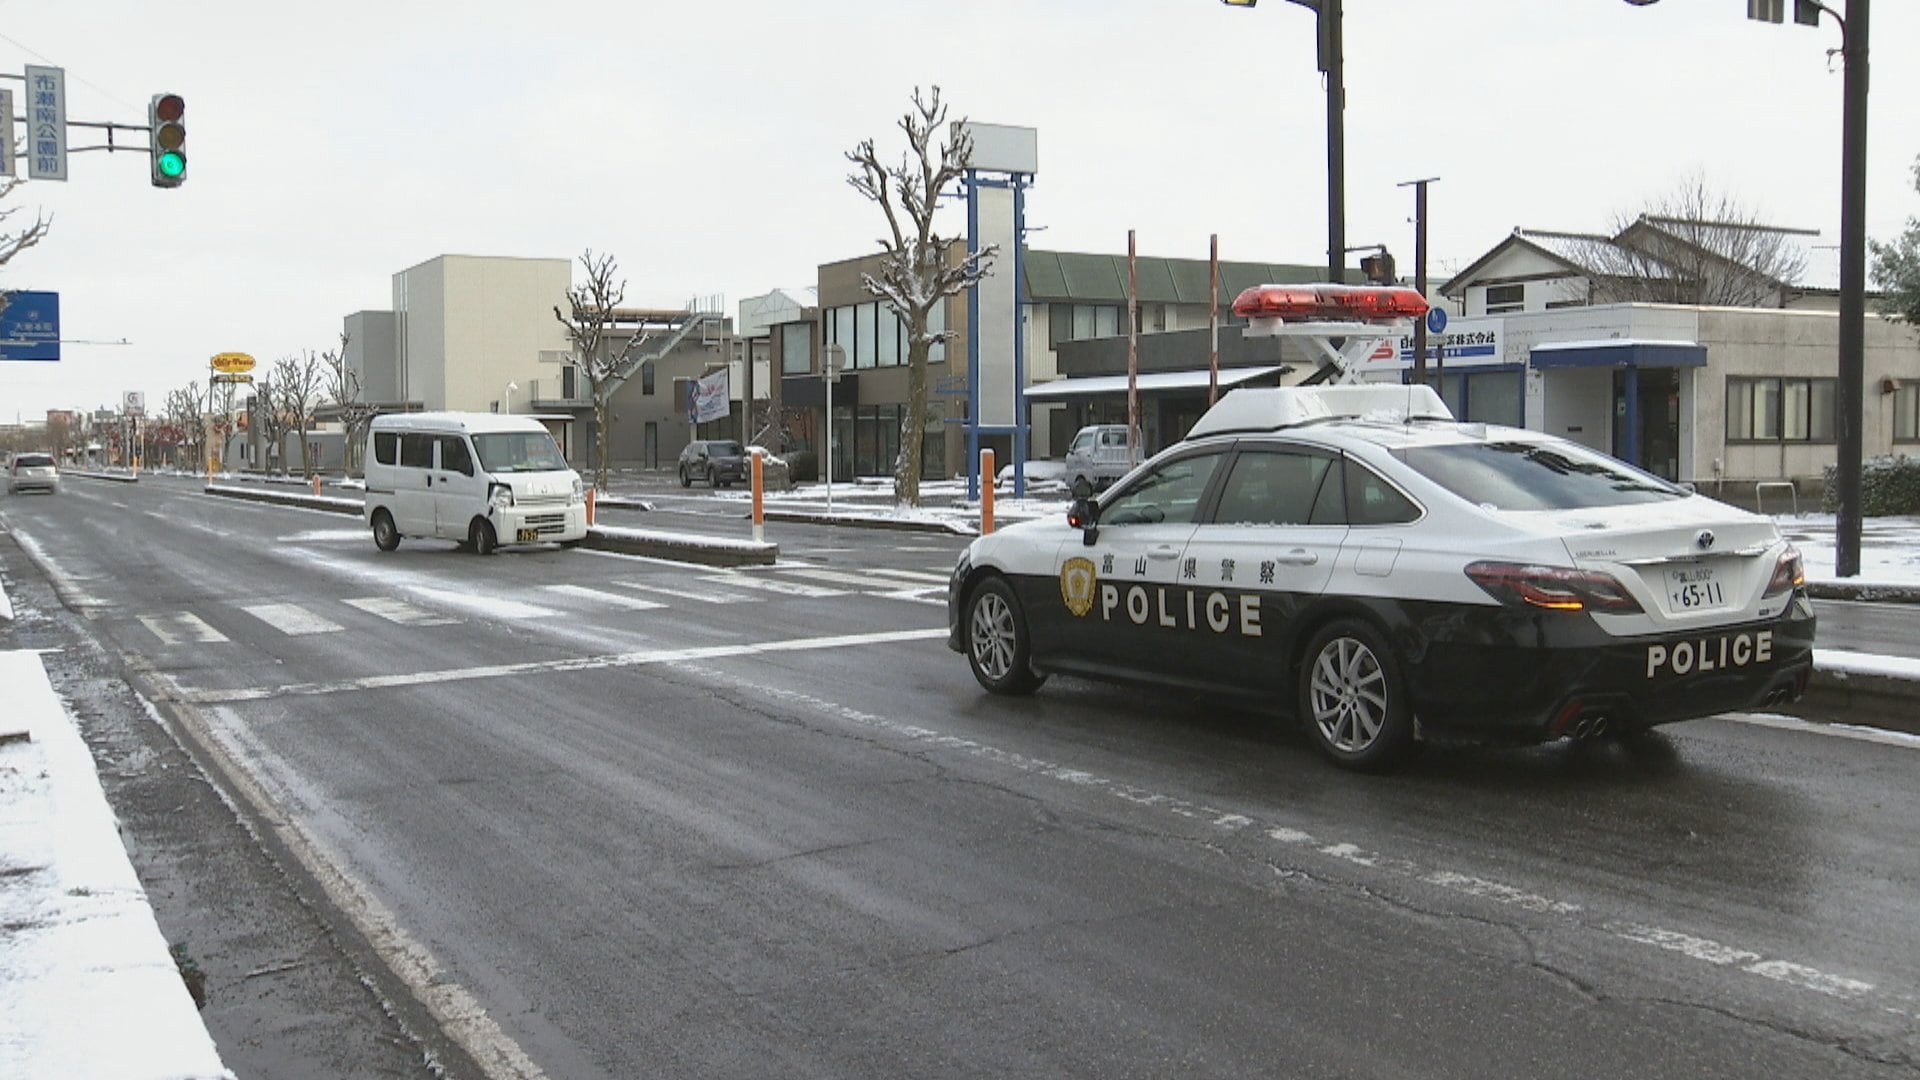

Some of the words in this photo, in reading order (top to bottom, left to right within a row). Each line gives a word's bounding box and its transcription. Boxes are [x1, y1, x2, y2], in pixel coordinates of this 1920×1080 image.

[34, 73, 58, 173] 布瀬南公園前
[1102, 552, 1276, 584] 富山県警察
[1101, 584, 1262, 637] POLICE
[1647, 630, 1773, 679] POLICE
